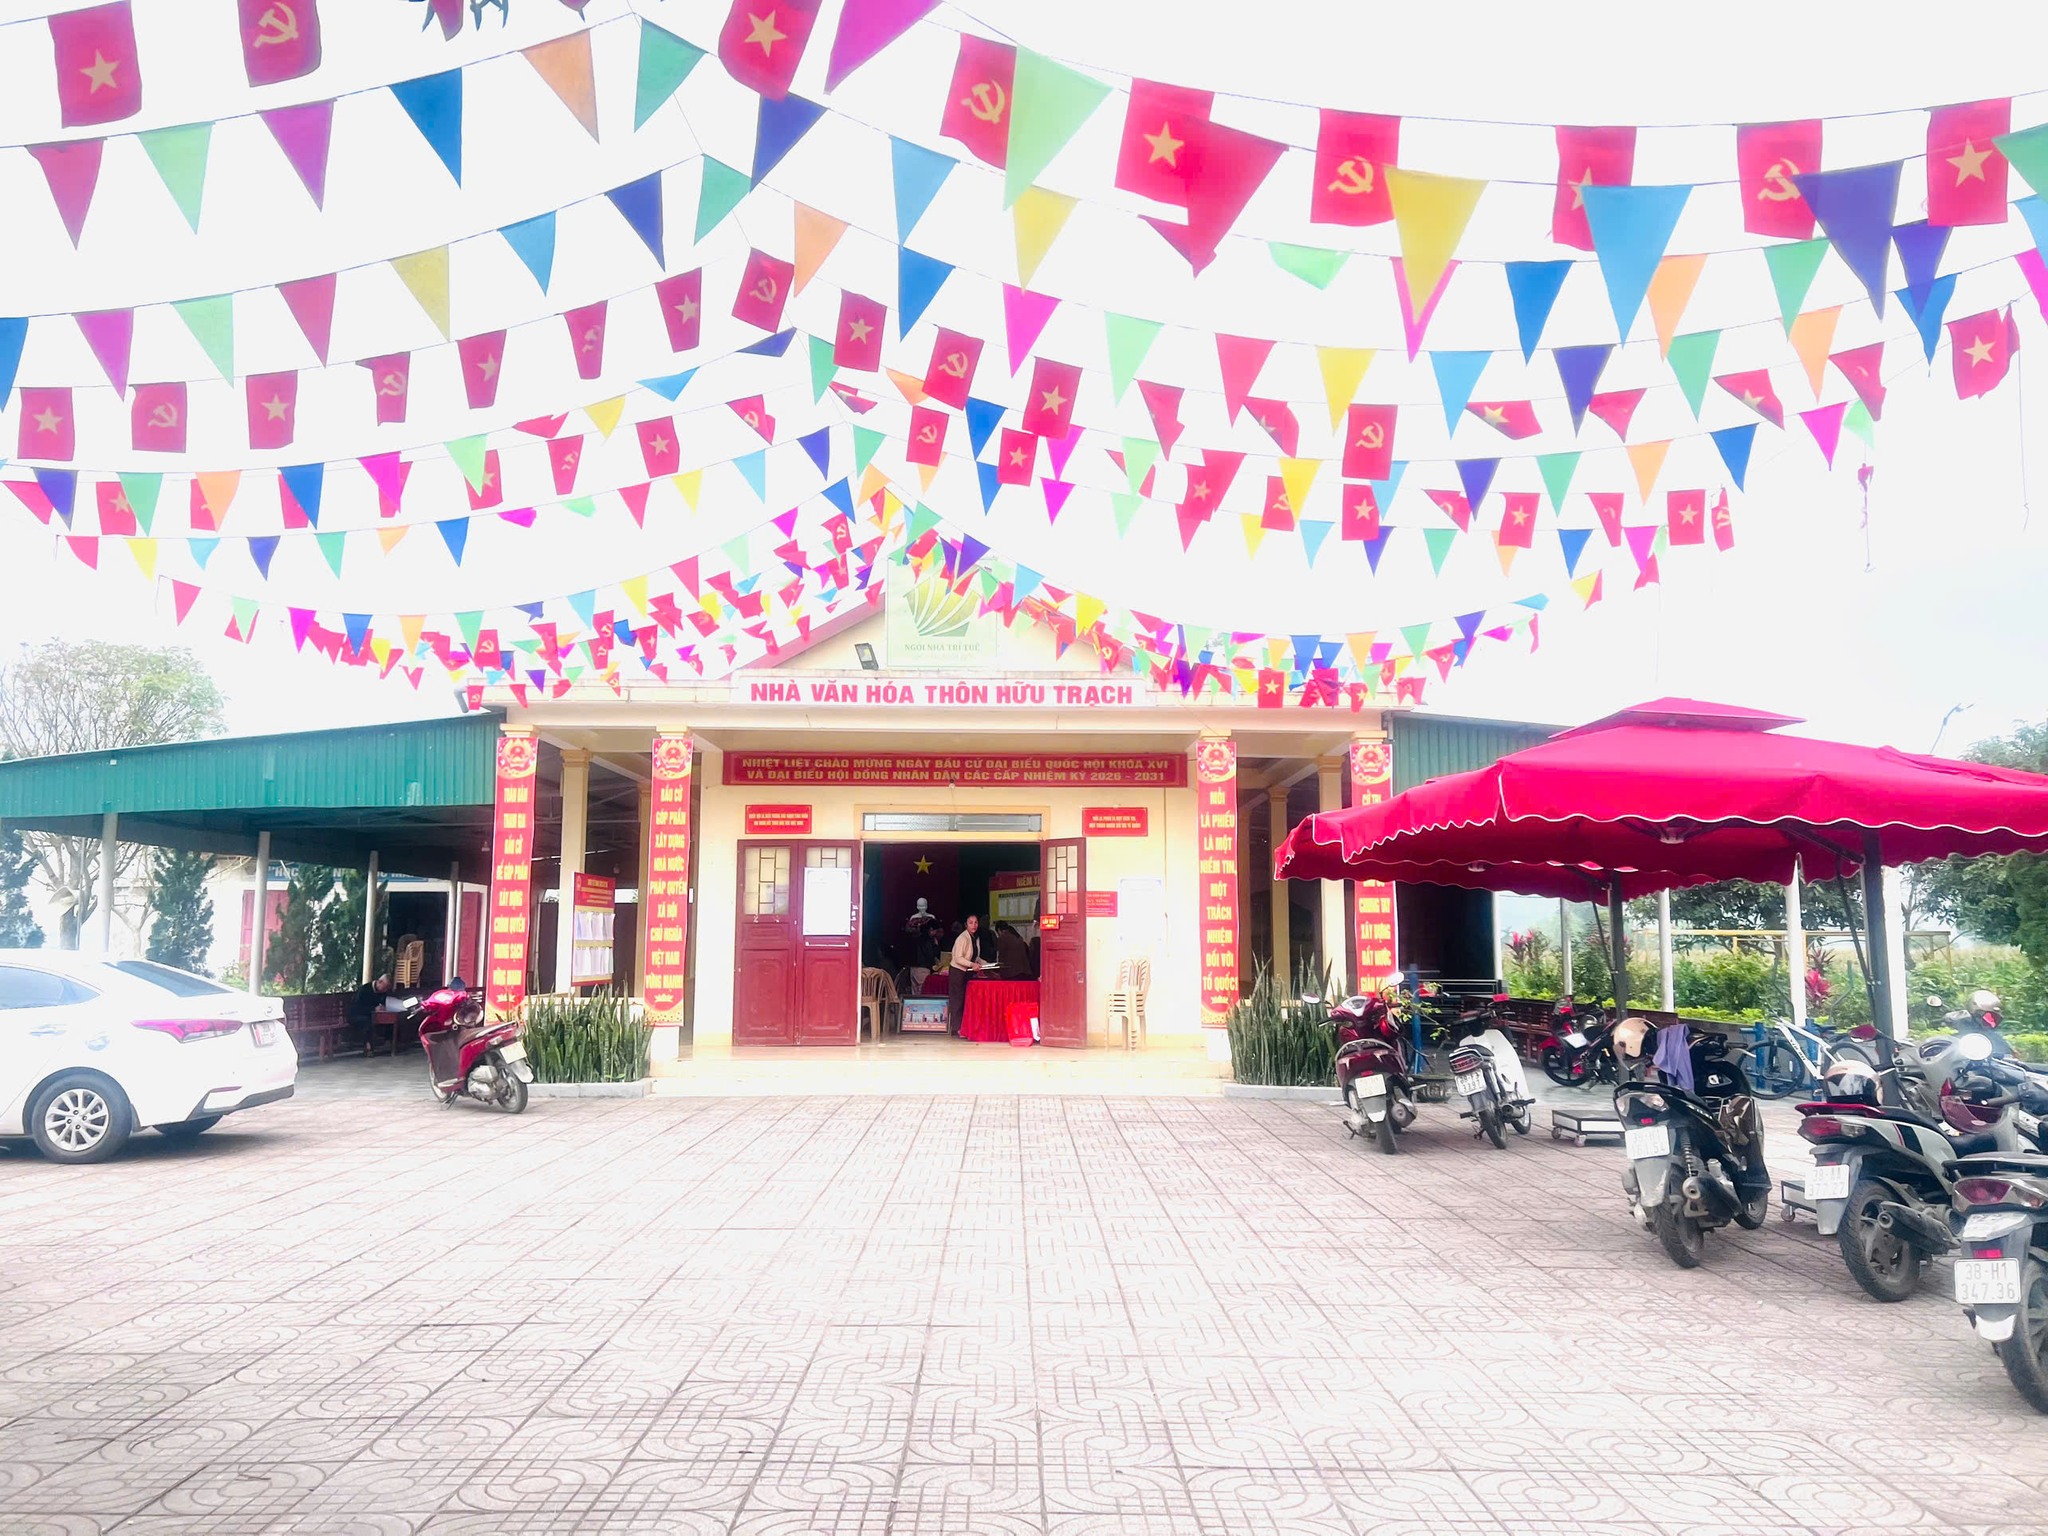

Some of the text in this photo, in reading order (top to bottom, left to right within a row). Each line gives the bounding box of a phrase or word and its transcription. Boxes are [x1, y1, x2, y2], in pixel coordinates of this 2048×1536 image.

[751, 680, 1132, 707] NHÀ VĂN HÓA THÔN HỮU TRẠCH
[747, 770, 763, 780] VÀ
[768, 770, 789, 781] ĐẠI
[794, 770, 823, 780] BIỂU
[827, 770, 849, 781] HỘI
[853, 770, 888, 780] ĐỒNG
[892, 770, 929, 780] NHÂN
[933, 770, 960, 780] DÂN
[964, 769, 989, 780] CÁC
[993, 768, 1019, 780] CẤP
[1023, 769, 1066, 781] NHIỆM
[1070, 770, 1088, 780] KỲ
[1090, 771, 1121, 781] 2026
[1134, 771, 1164, 781] 2031
[1965, 1262, 2007, 1280] 38-H1
[1961, 1282, 2015, 1301] 347.36
